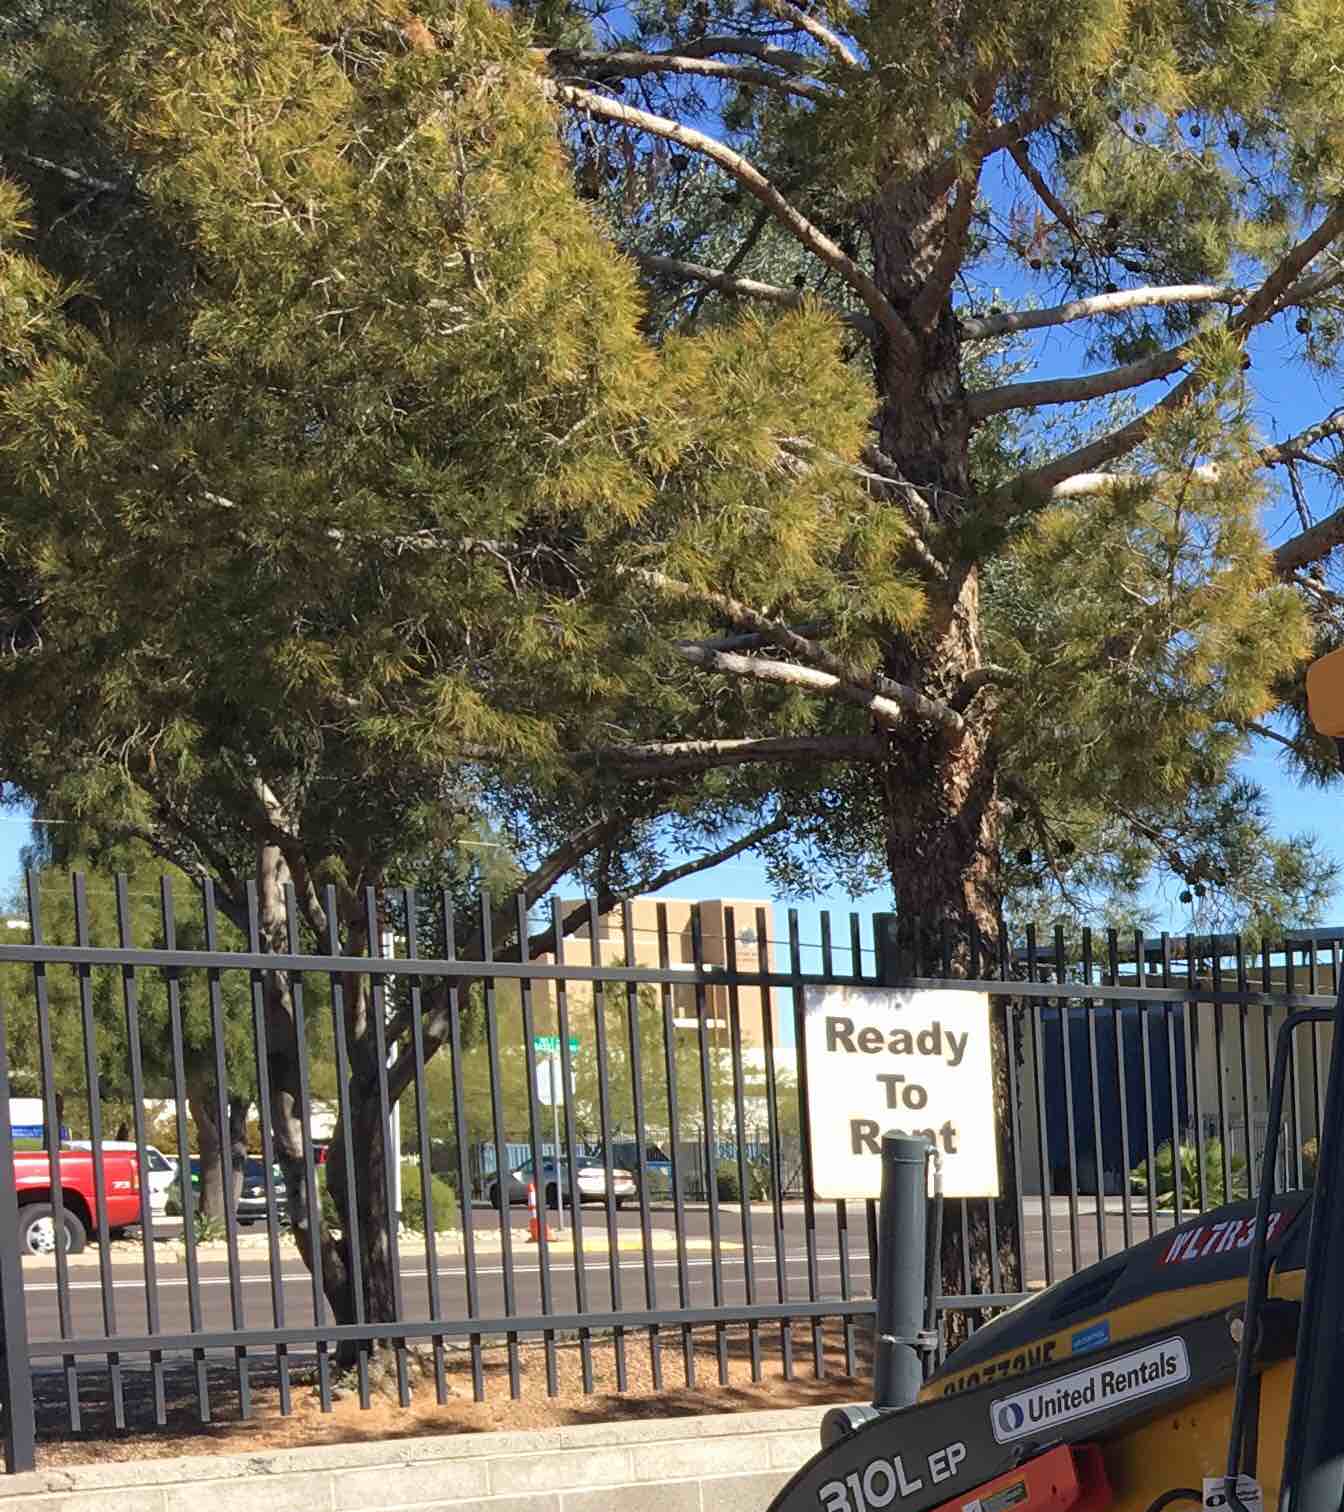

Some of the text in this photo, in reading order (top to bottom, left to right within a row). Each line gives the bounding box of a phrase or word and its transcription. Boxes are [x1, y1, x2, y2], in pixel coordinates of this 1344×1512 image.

[825, 1015, 969, 1067] Ready
[876, 1073, 929, 1110] To
[1028, 1377, 1096, 1423] United
[1101, 1353, 1177, 1398] Rentals
[928, 1442, 967, 1485] EP
